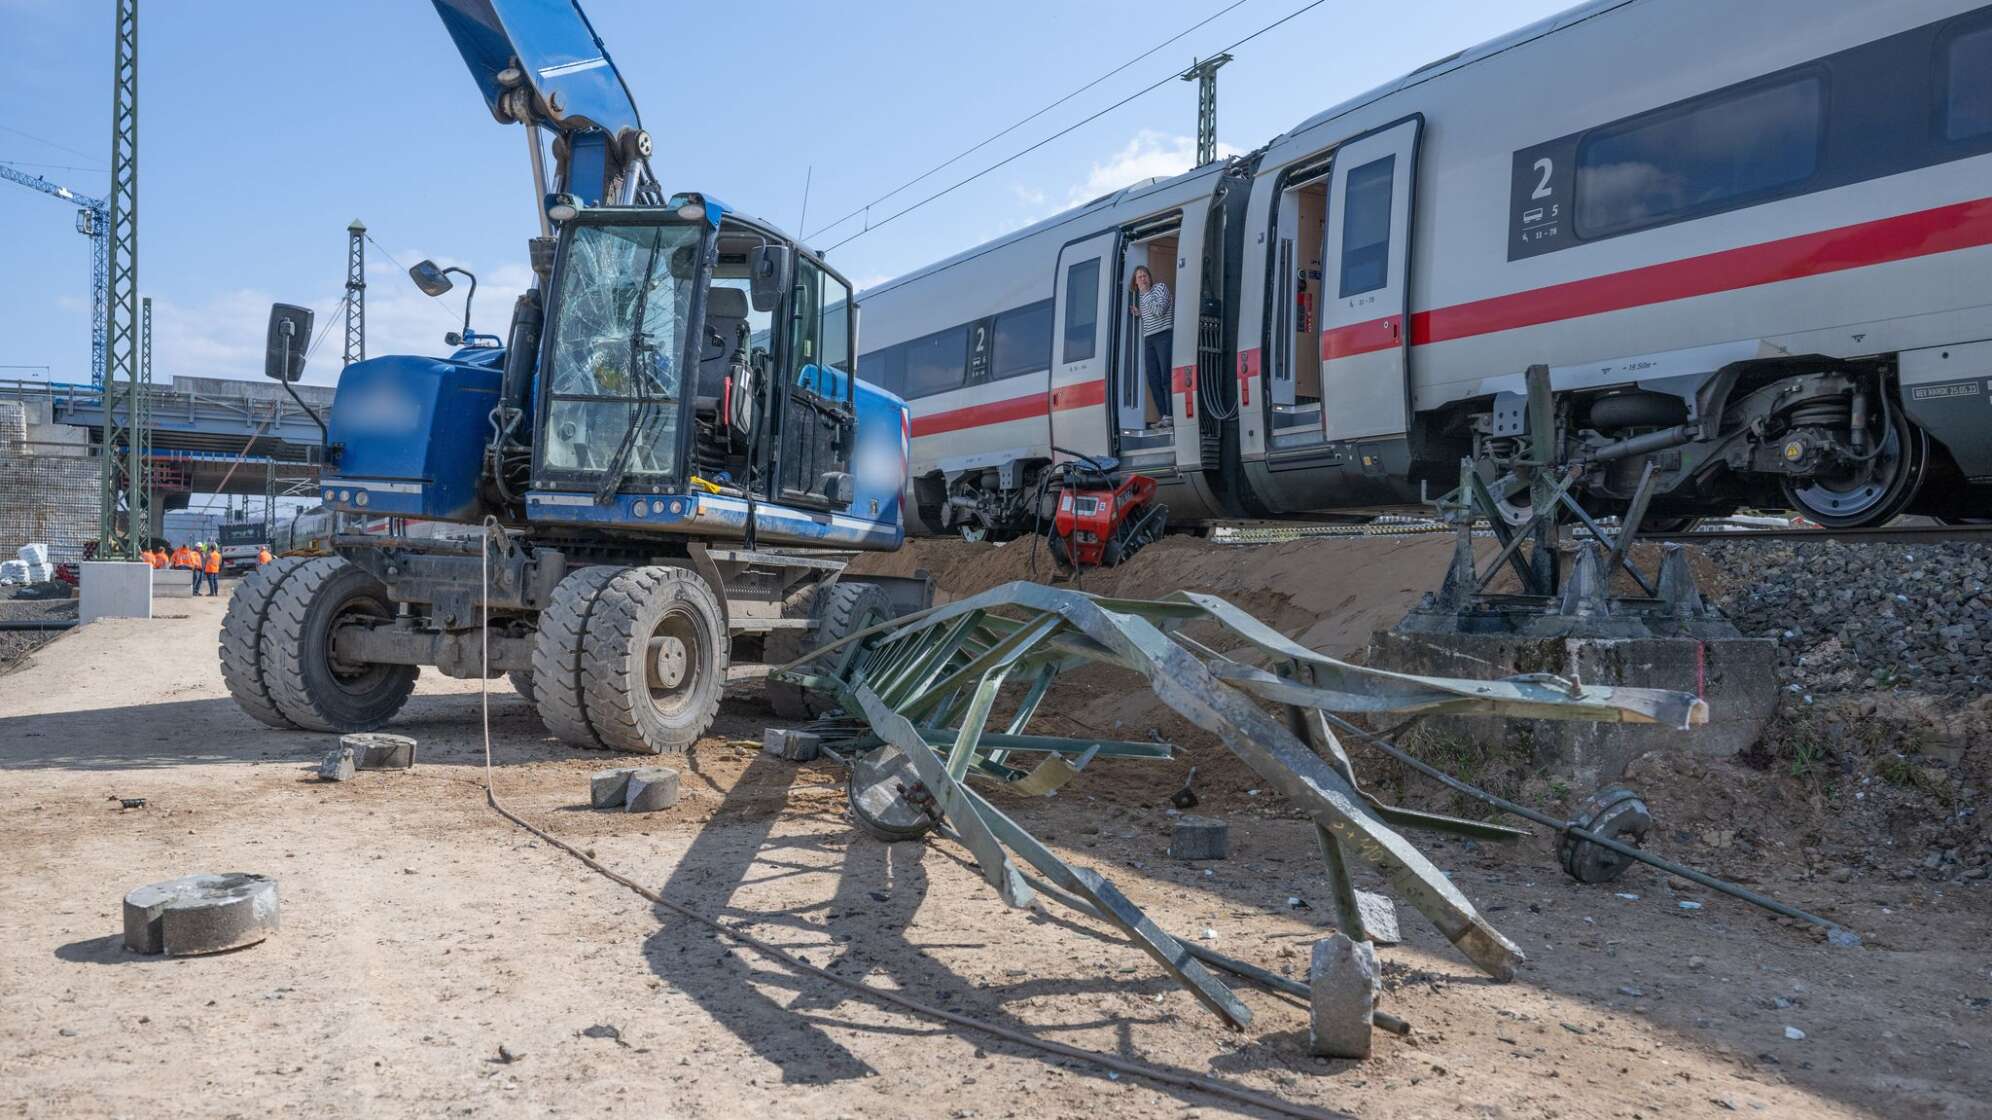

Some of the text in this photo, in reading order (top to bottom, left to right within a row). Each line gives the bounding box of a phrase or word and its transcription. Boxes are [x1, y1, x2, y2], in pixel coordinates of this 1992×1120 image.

[1532, 157, 1552, 200] 2
[1552, 204, 1559, 217] 5
[976, 327, 985, 352] 2
